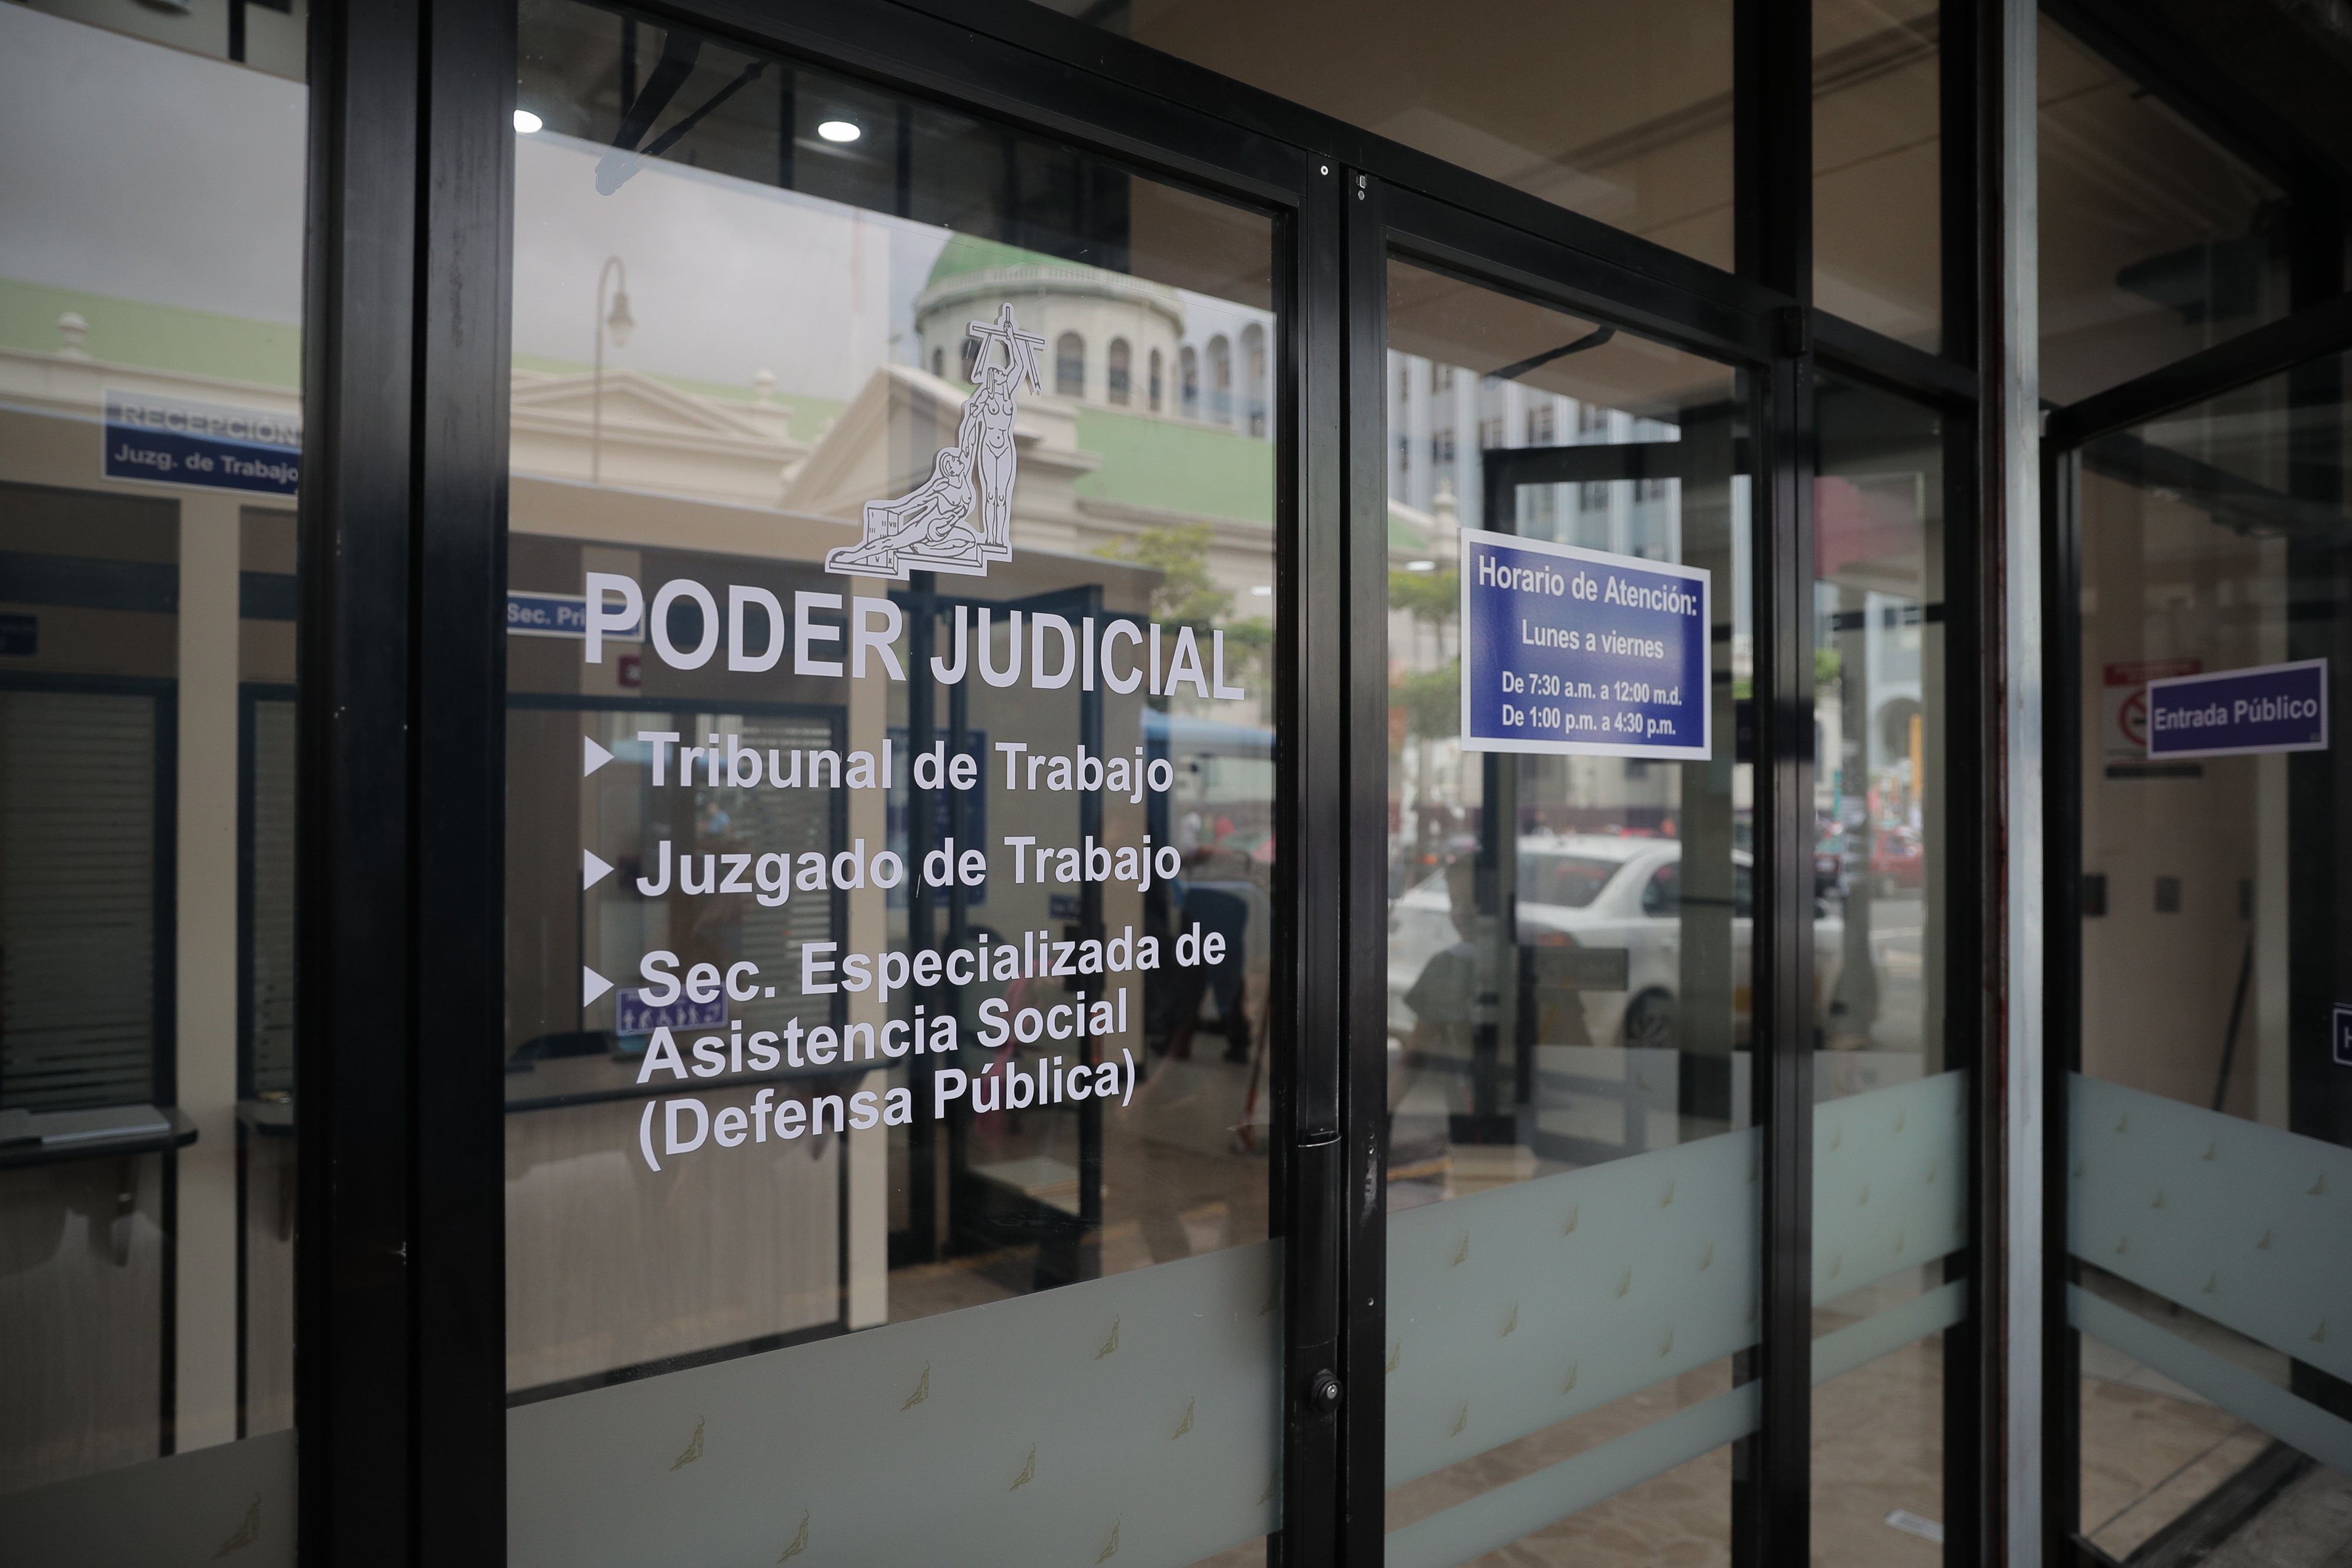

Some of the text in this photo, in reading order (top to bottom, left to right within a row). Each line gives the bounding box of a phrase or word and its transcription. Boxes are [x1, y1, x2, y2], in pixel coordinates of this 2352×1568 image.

[115, 444, 298, 484] Juzg. de Trabajo
[507, 602, 552, 625] Sec.
[1479, 554, 1697, 616] Horario de Atención:
[585, 571, 1245, 701] PODER JUDICIAL
[1522, 618, 1665, 660] Lunes a viernes
[1502, 670, 1682, 706] De 7:30 a.m. a 12:00 m.d.
[2154, 695, 2318, 731] Entrada Público
[1502, 704, 1676, 739] De 1:00 p.m. a 4:30 p.m.
[637, 731, 1174, 804] Tribunal de Trabajo
[636, 834, 1181, 907] Juzgado de Trabajo
[638, 922, 1226, 1007] Sec. Especializada de
[636, 987, 1127, 1084] Asistencia Social
[639, 1048, 1135, 1172] (Defensa Pública)
